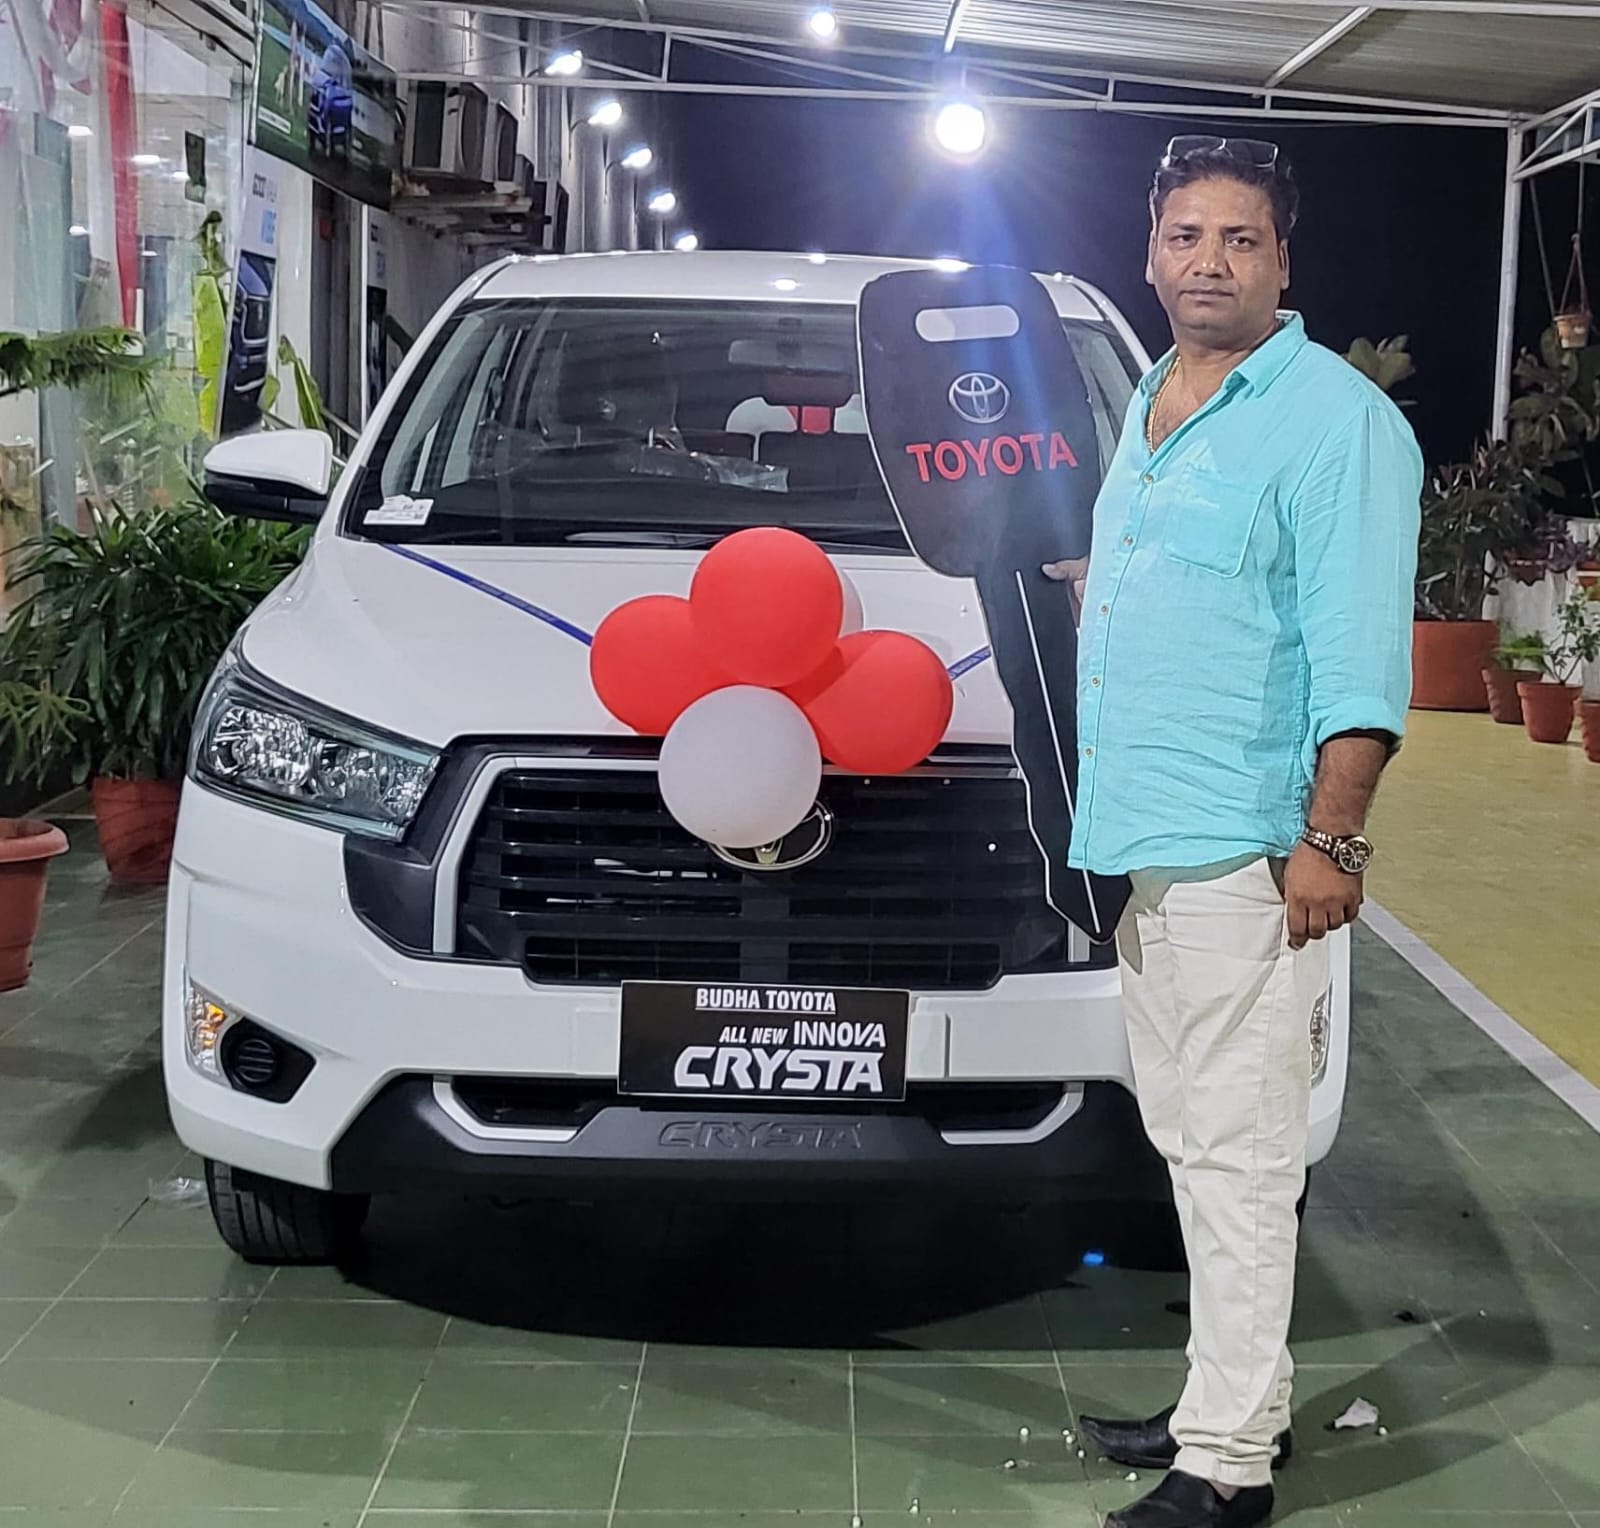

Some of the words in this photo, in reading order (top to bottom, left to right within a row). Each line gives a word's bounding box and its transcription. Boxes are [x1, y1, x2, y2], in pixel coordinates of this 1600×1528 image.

[906, 431, 1079, 483] TOYOTA
[696, 988, 760, 1009] BUDHA
[766, 990, 836, 1012] TOYOTA
[719, 1026, 747, 1044] ALL
[751, 1027, 788, 1045] NEW
[793, 1021, 886, 1047] INNOVA
[674, 1046, 884, 1092] CRYSTA
[658, 1121, 862, 1149] CRYSTA
